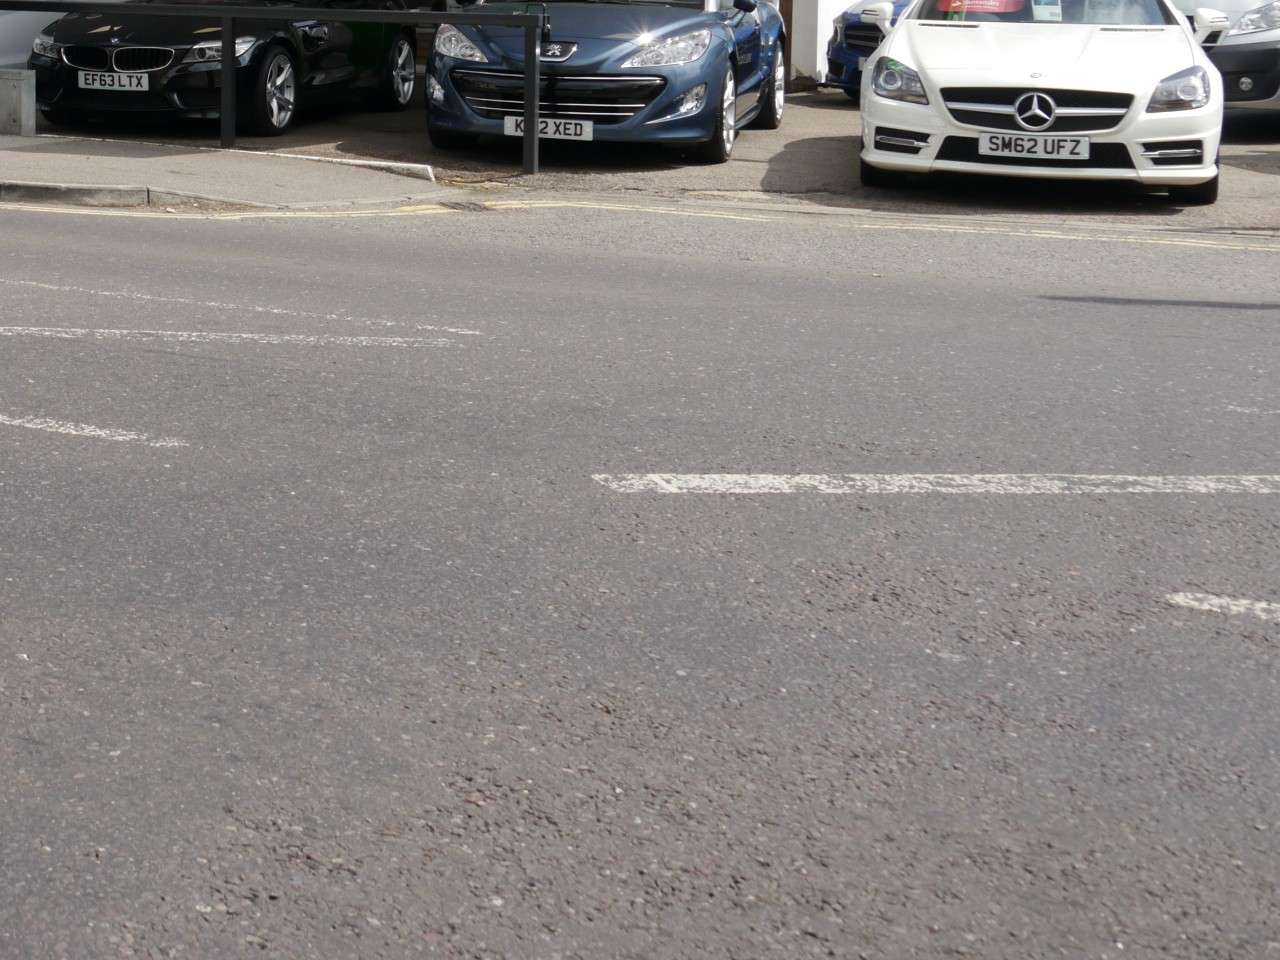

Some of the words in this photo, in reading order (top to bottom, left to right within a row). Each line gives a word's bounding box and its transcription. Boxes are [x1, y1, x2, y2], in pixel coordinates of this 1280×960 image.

[84, 72, 115, 87] EF63
[118, 74, 143, 89] LTX
[514, 118, 548, 135] K2
[553, 121, 584, 137] XED
[988, 135, 1038, 154] SM62
[1043, 138, 1081, 156] UFZ
